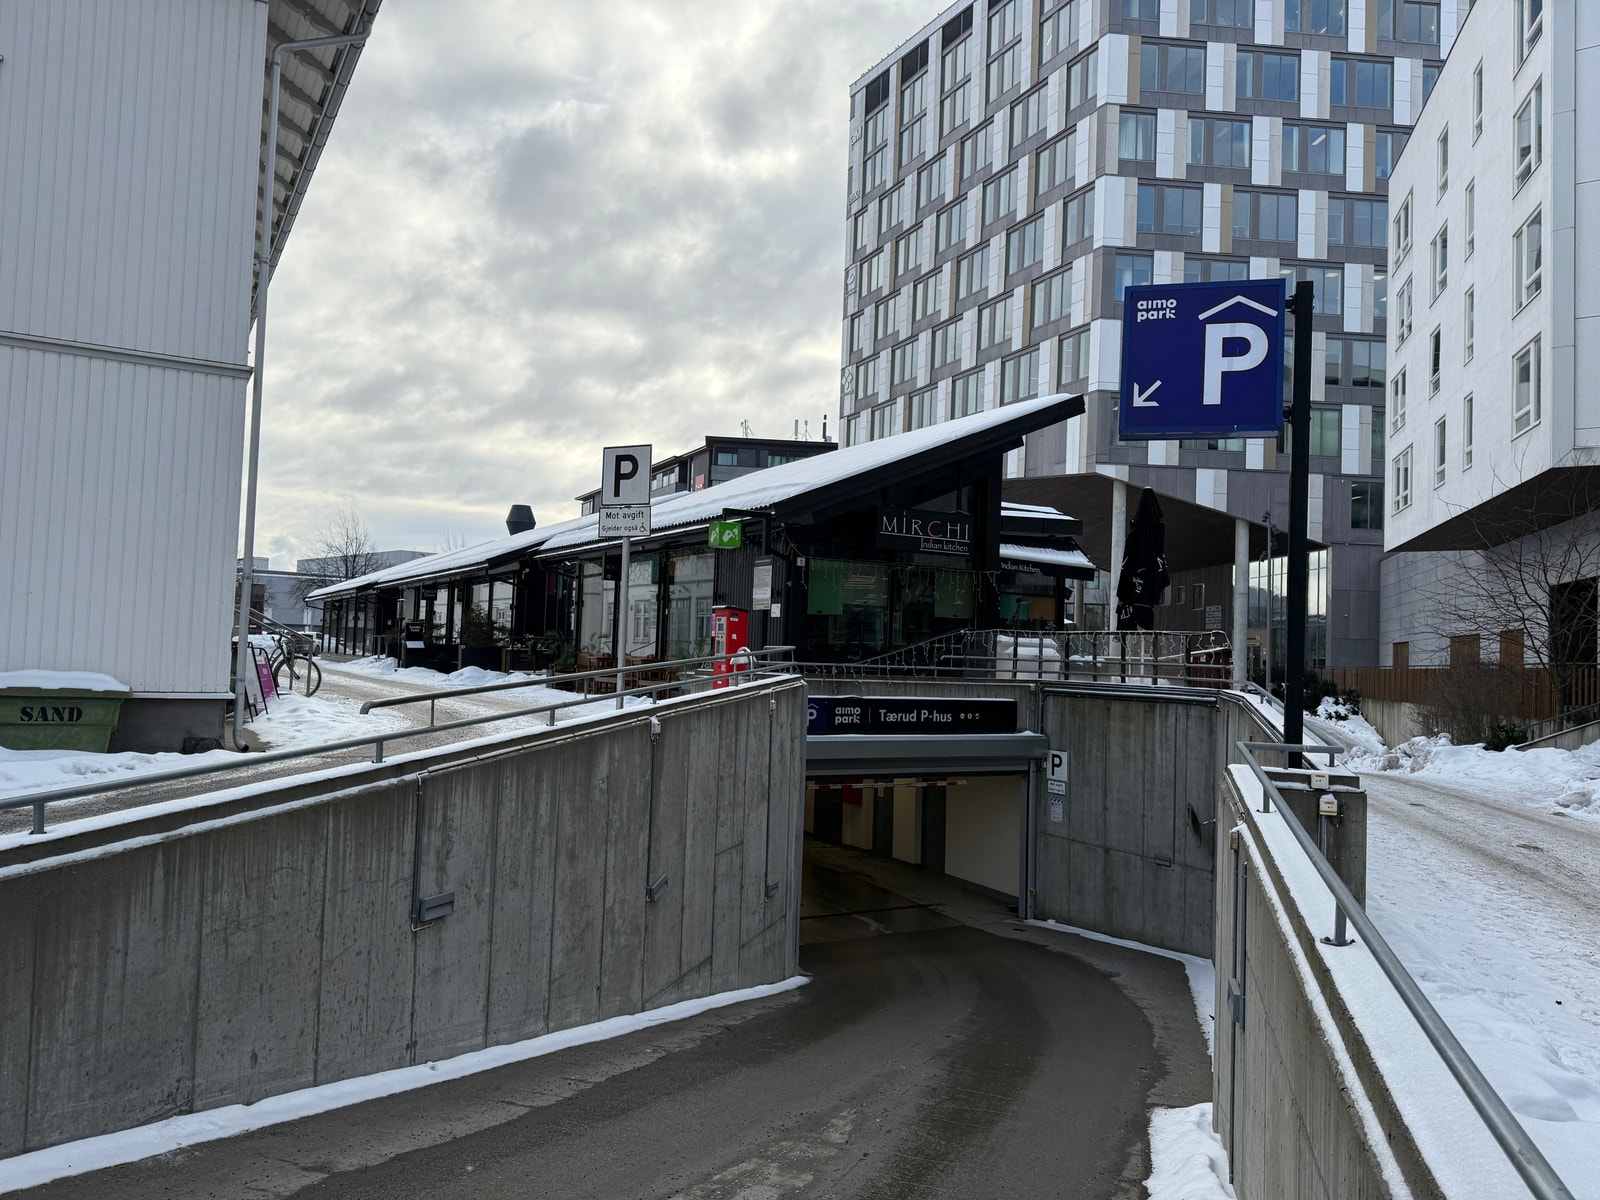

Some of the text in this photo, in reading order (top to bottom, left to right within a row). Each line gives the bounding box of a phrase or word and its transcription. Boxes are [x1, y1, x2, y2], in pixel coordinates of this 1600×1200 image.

[1137, 299, 1177, 309] aimo
[1137, 308, 1176, 322] park
[1202, 322, 1269, 406] P
[613, 454, 639, 498] P
[605, 510, 644, 520] Mot avgift
[602, 525, 622, 533] Gjelder
[920, 538, 968, 552] Indian kitchen
[20, 706, 83, 722] SAND
[835, 707, 861, 715] aimo
[879, 709, 952, 722] Tærud P-hus
[835, 714, 861, 725] park
[1051, 753, 1063, 777] P
